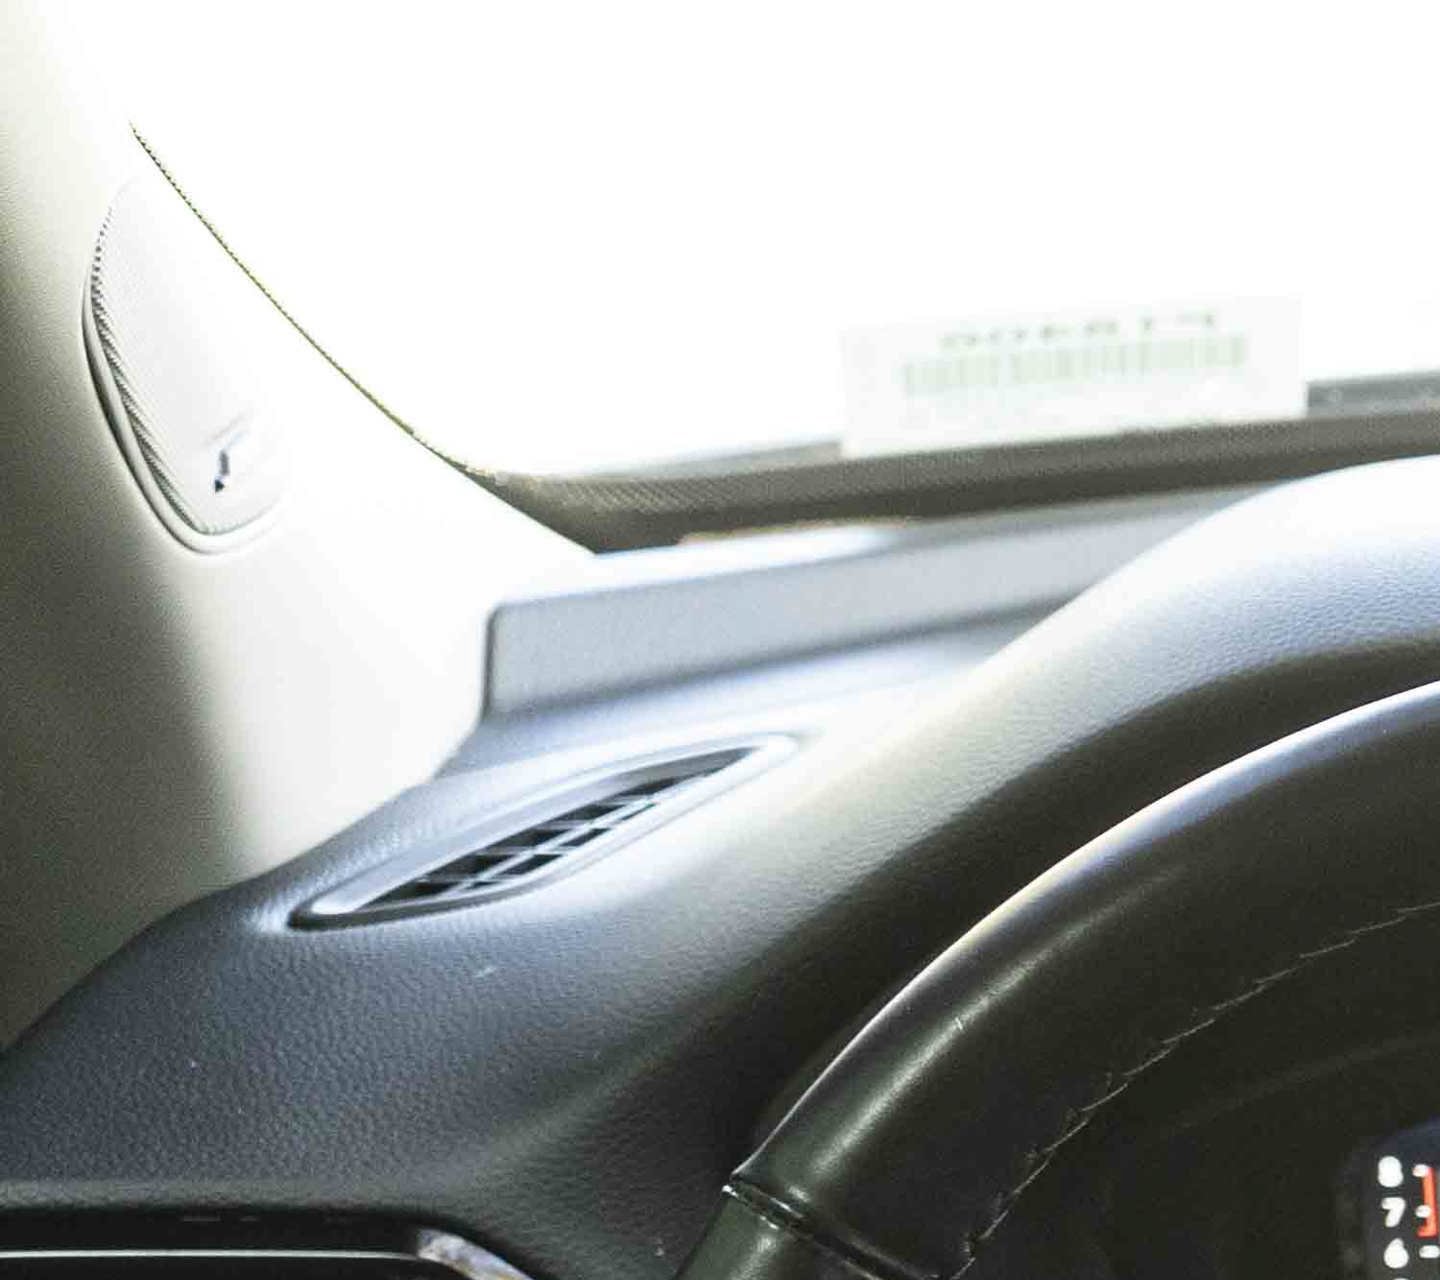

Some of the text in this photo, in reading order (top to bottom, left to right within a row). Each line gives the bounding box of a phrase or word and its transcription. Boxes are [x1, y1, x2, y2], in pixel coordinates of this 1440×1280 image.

[1378, 1155, 1404, 1188] 8
[1381, 1197, 1406, 1228] 7
[1383, 1238, 1409, 1268] 6
